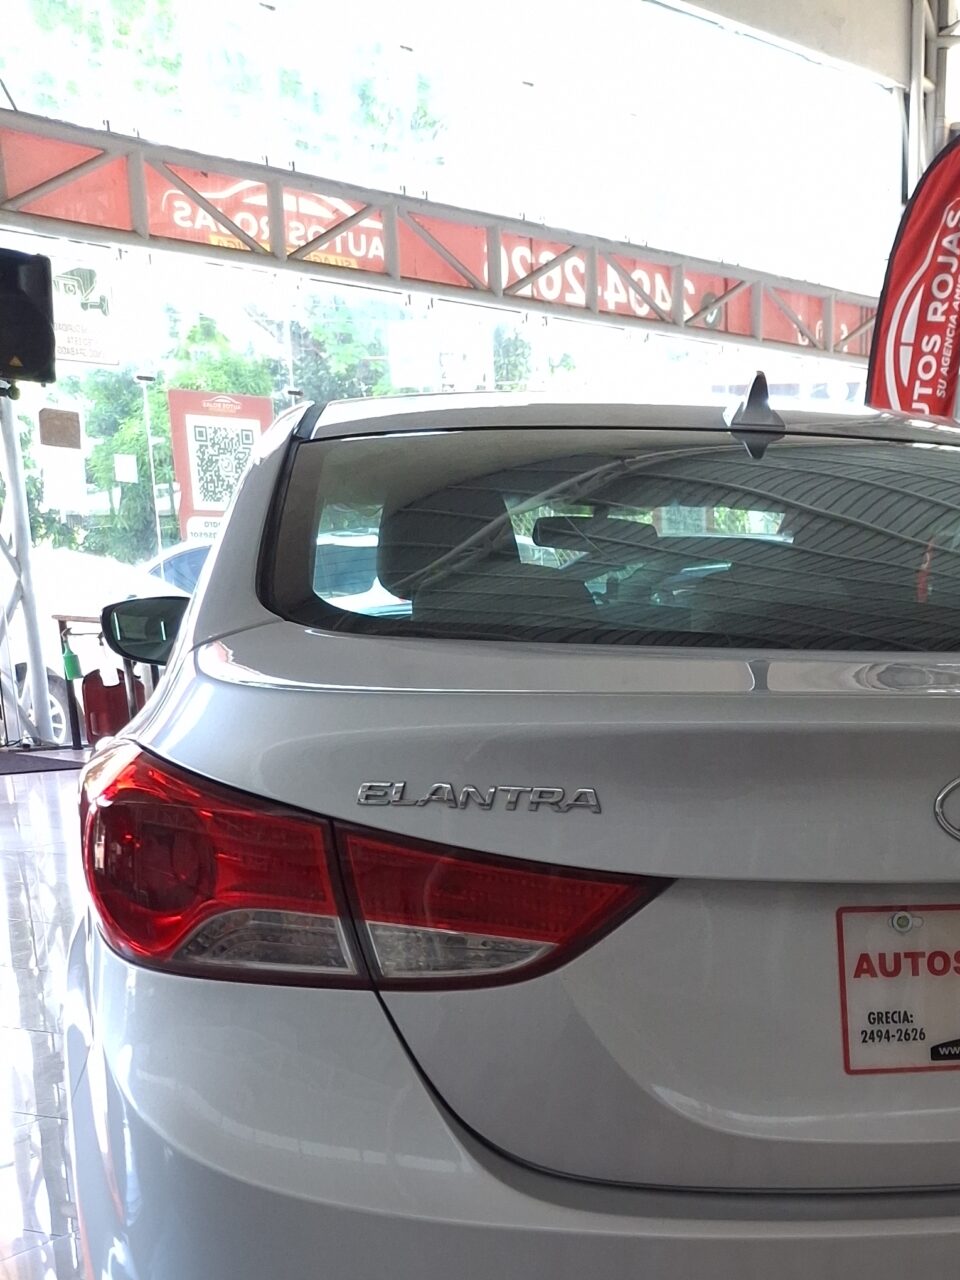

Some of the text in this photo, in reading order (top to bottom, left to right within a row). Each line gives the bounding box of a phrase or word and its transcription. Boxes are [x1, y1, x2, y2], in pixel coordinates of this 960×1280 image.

[938, 314, 958, 377] AGENCIA
[911, 333, 941, 416] UTOS
[936, 378, 946, 399] SU
[356, 781, 602, 815] ELANTRA
[867, 1010, 914, 1026] GRECIA:
[860, 1028, 926, 1044] 2494-2626
